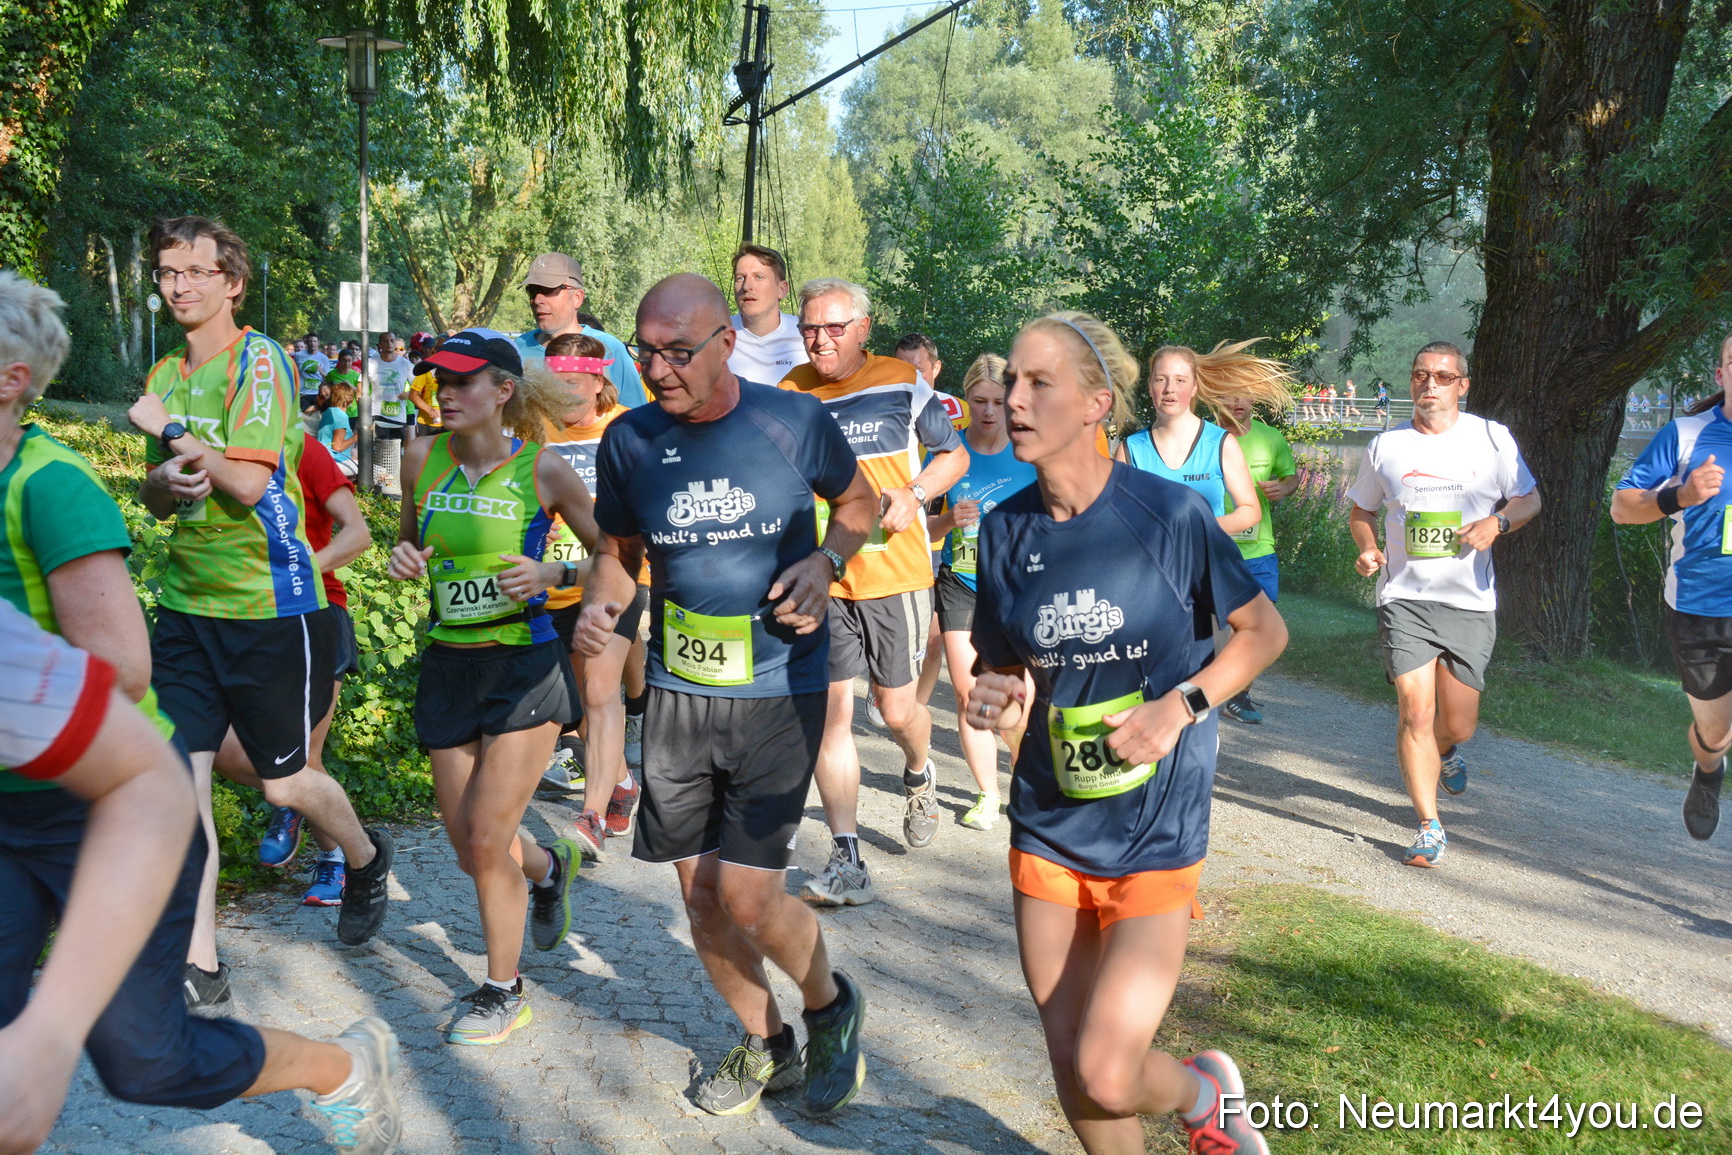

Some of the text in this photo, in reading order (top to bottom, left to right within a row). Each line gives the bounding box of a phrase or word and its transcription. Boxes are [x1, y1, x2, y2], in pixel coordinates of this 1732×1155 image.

[246, 338, 274, 428] BOCK
[1183, 473, 1210, 482] THULE
[1414, 484, 1463, 493] Seniorenstift
[426, 490, 519, 521] BOCK
[666, 486, 756, 527] Burgis
[651, 517, 782, 546] Weil's guad is!
[1409, 527, 1454, 544] 1820
[447, 577, 499, 606] 204
[482, 600, 508, 610] Kerstin
[1034, 598, 1125, 649] Burgis
[677, 633, 728, 666] 294
[1072, 643, 1121, 671] guad
[1126, 639, 1149, 659] is!
[698, 664, 723, 674] Fabian
[1073, 769, 1122, 784] Rupp Nina
[1101, 779, 1120, 788] GmbH
